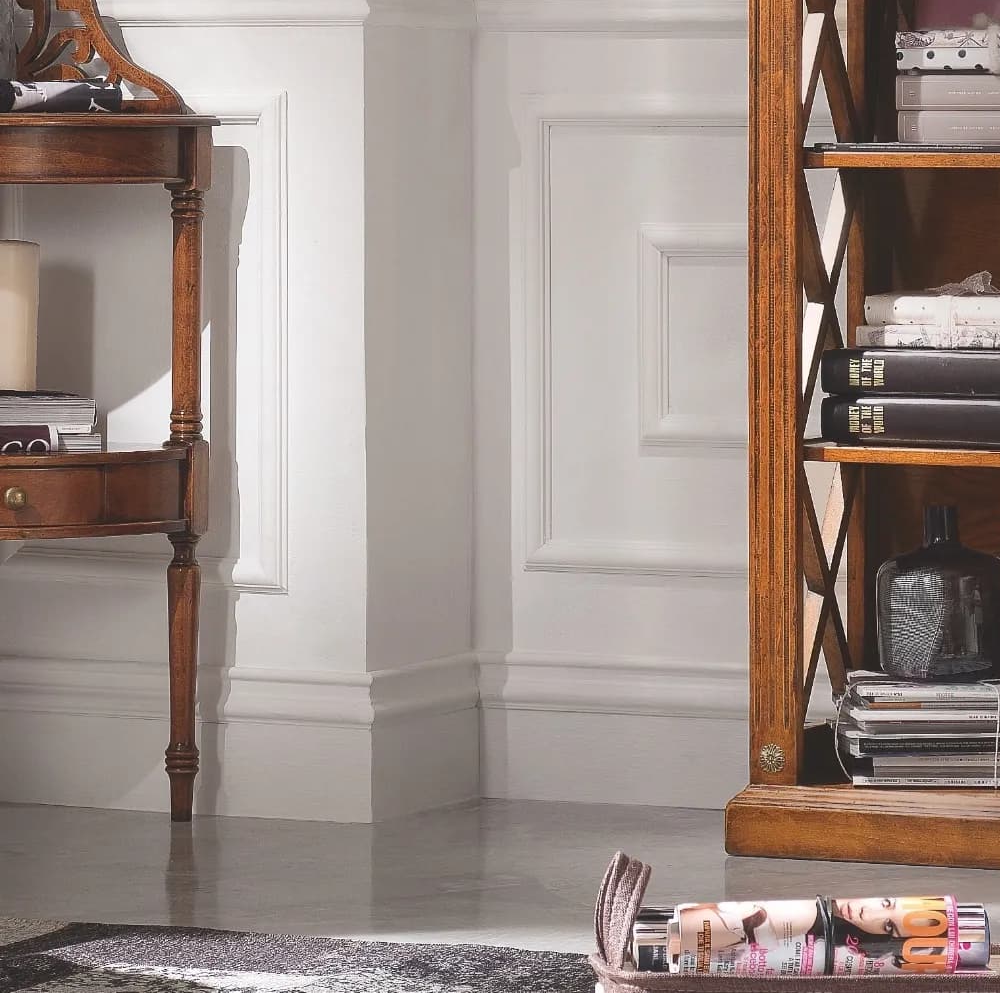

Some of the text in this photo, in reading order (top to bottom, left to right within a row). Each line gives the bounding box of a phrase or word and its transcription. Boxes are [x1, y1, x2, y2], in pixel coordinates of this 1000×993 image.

[849, 358, 860, 387] MONEY
[861, 358, 872, 386] OF THE
[873, 359, 885, 387] WORLD
[849, 405, 860, 433] MONEY
[861, 405, 872, 434] OF THE
[873, 405, 885, 434] WORLD
